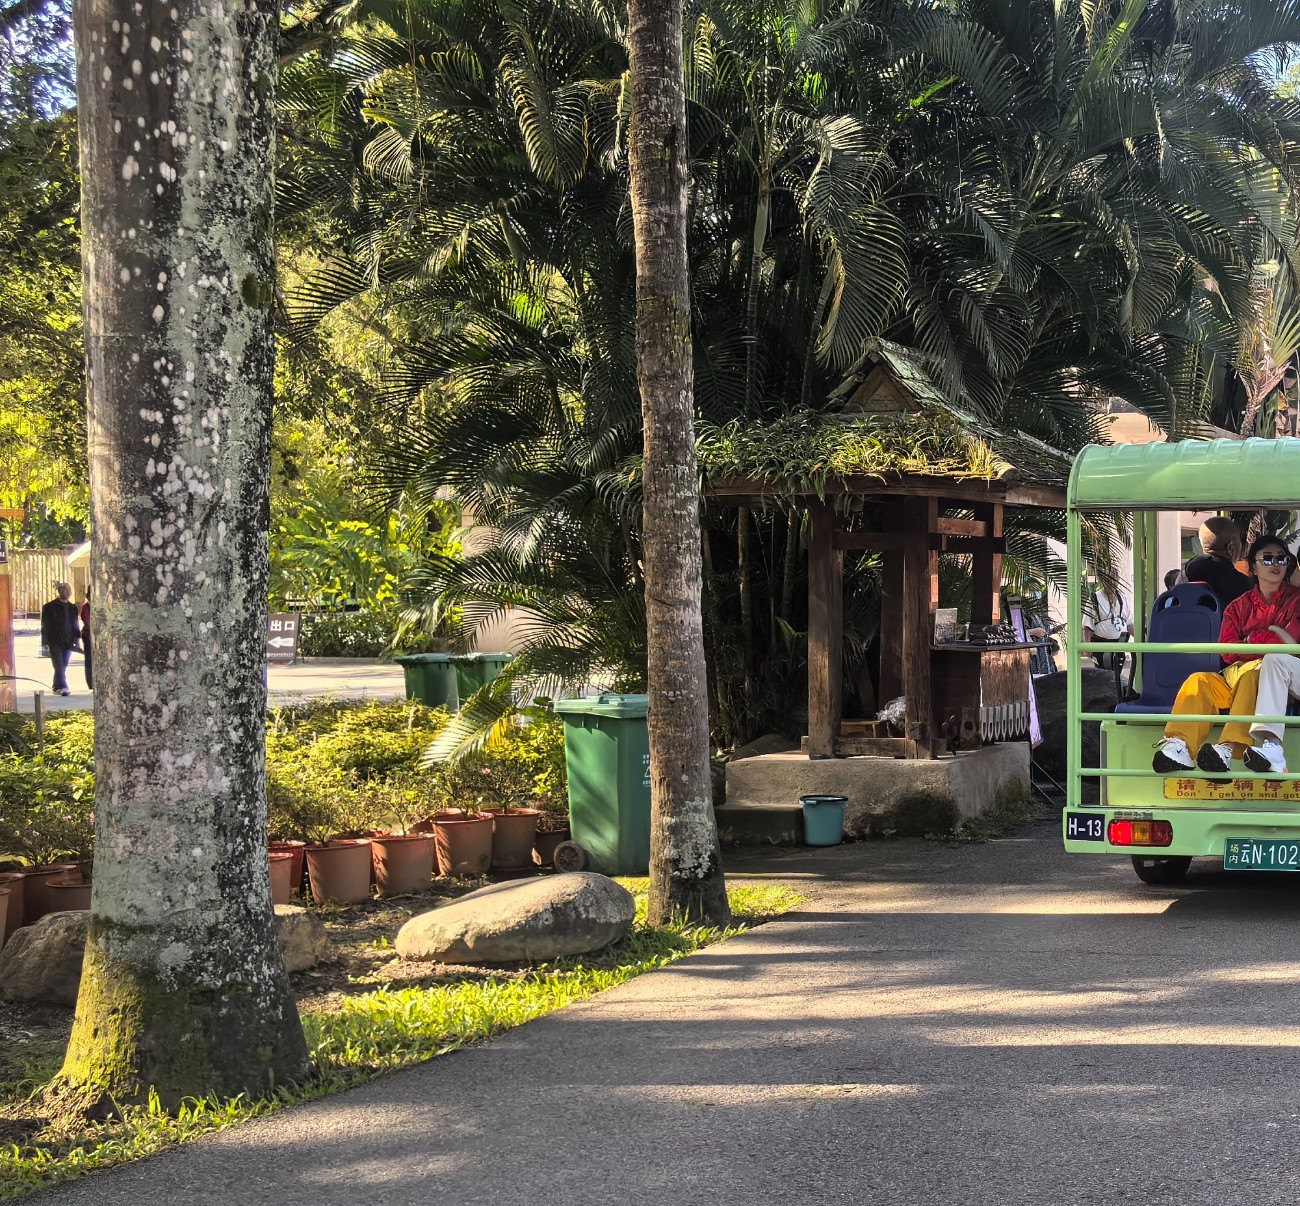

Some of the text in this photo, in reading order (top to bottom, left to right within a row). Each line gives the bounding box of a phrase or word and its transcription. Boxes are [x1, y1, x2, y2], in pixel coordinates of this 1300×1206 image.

[270, 620, 295, 631] 出口
[1219, 791, 1235, 799] get
[1068, 817, 1102, 837] H-13
